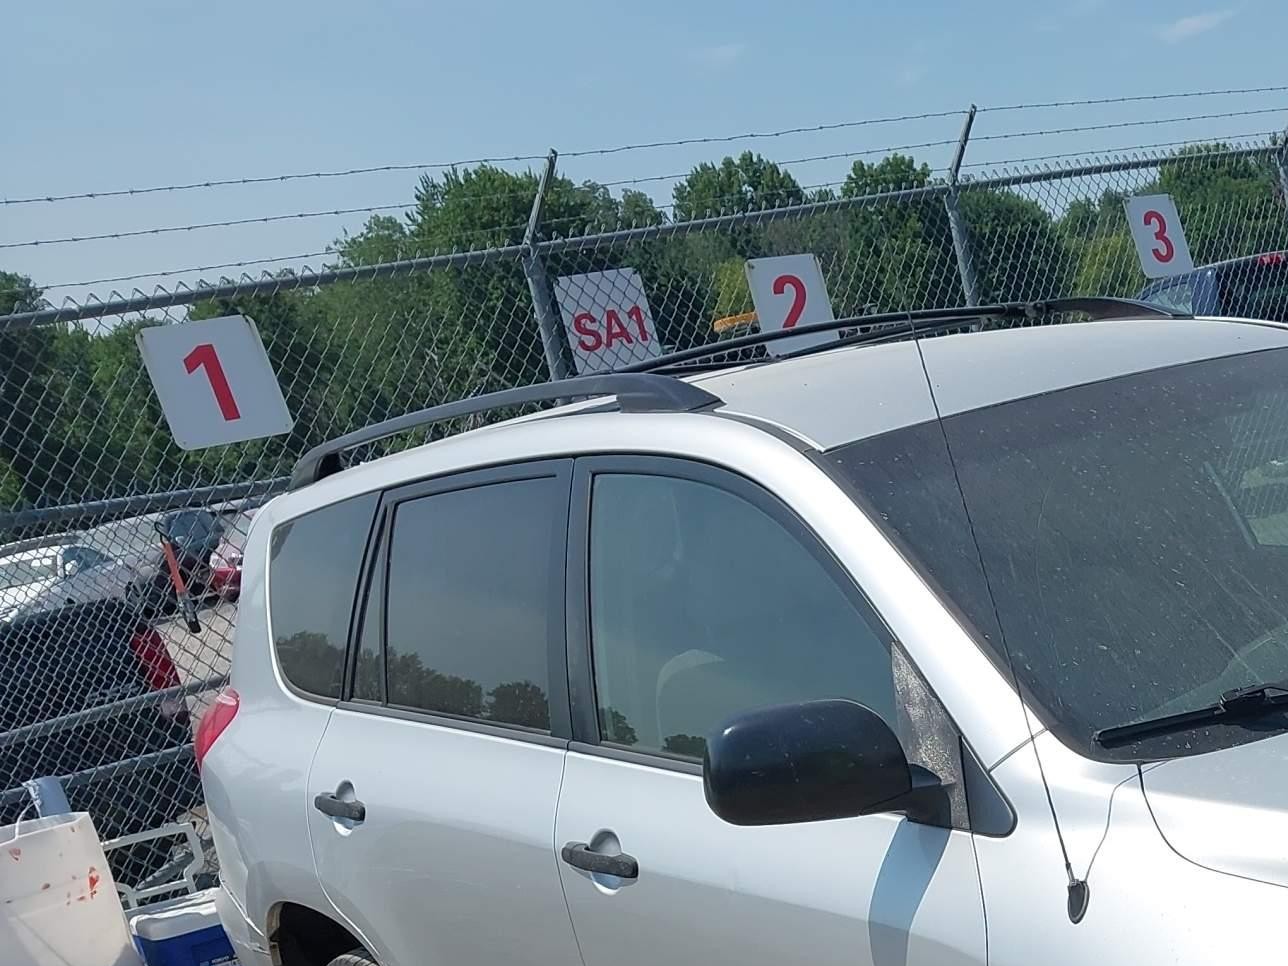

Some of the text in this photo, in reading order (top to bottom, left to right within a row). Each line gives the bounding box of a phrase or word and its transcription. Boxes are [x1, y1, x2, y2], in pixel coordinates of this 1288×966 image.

[1143, 209, 1175, 264] 3
[573, 305, 649, 351] SA1
[772, 274, 807, 332] 2
[183, 343, 241, 421] 1
